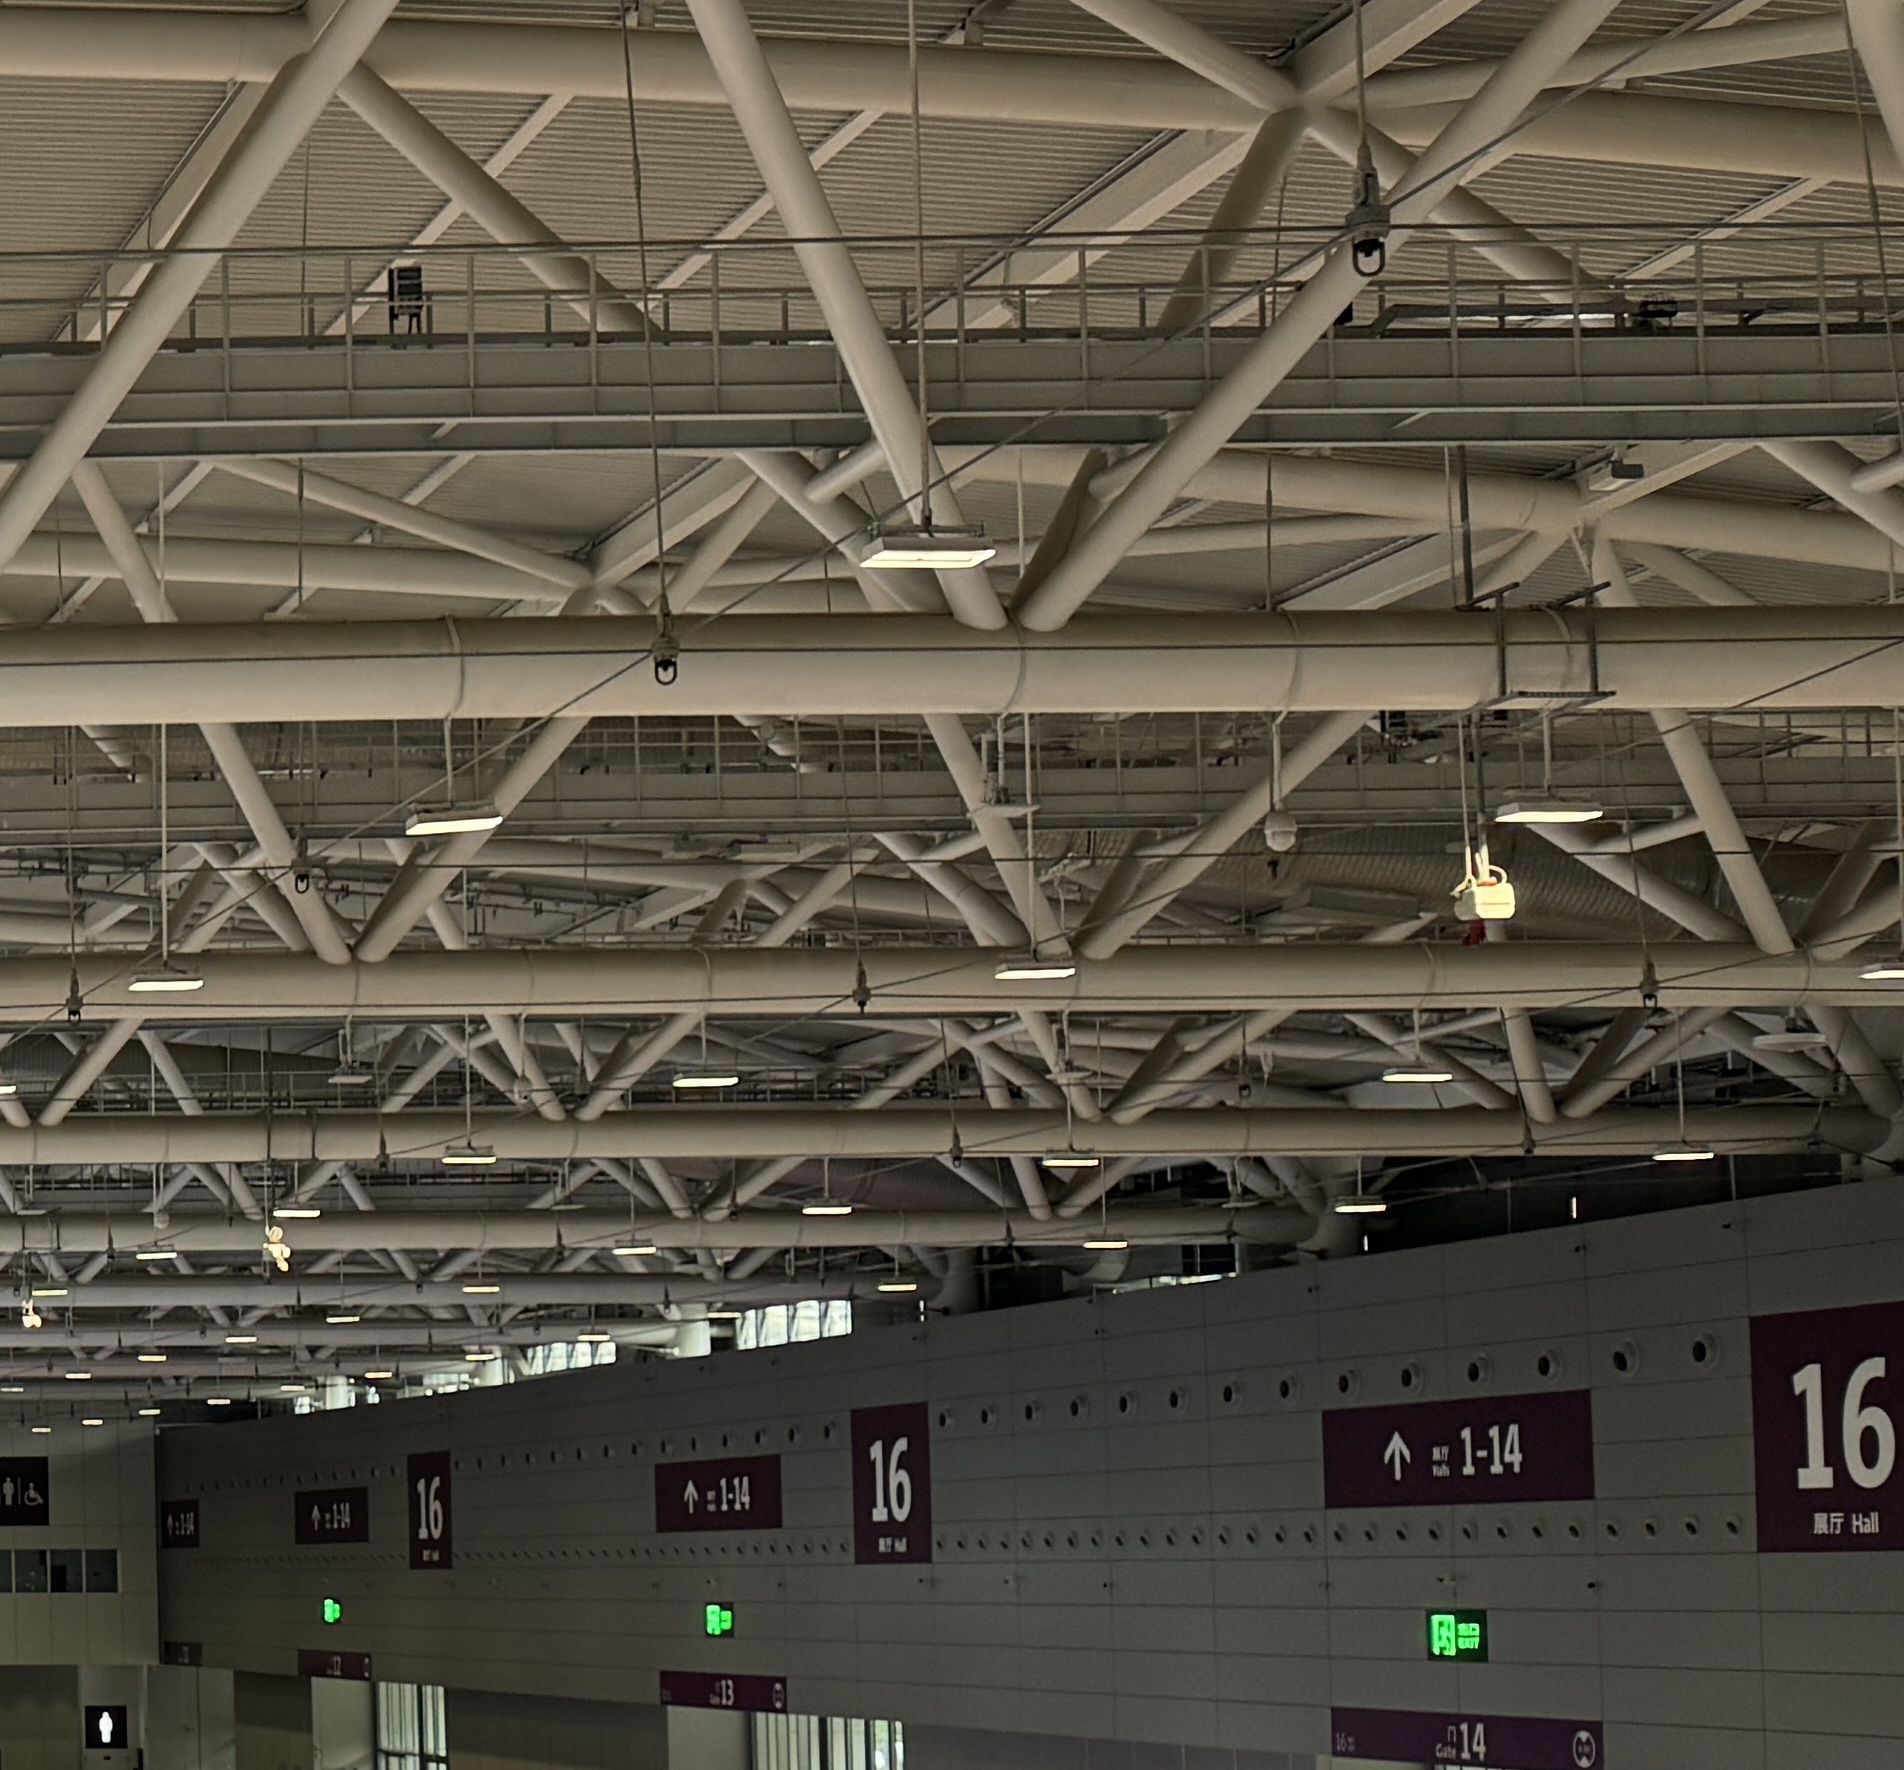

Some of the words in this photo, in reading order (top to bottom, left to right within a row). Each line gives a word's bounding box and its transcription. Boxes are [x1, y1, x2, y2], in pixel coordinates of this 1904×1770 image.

[1460, 1422, 1523, 1476] 1-14
[1791, 1356, 1897, 1490] 16
[720, 1476, 750, 1512] 1-14
[869, 1437, 912, 1522] 16
[417, 1476, 443, 1540] 16
[1813, 1513, 1845, 1535] 展厅
[1851, 1512, 1880, 1535] Hall
[1459, 1721, 1486, 1761] 14
